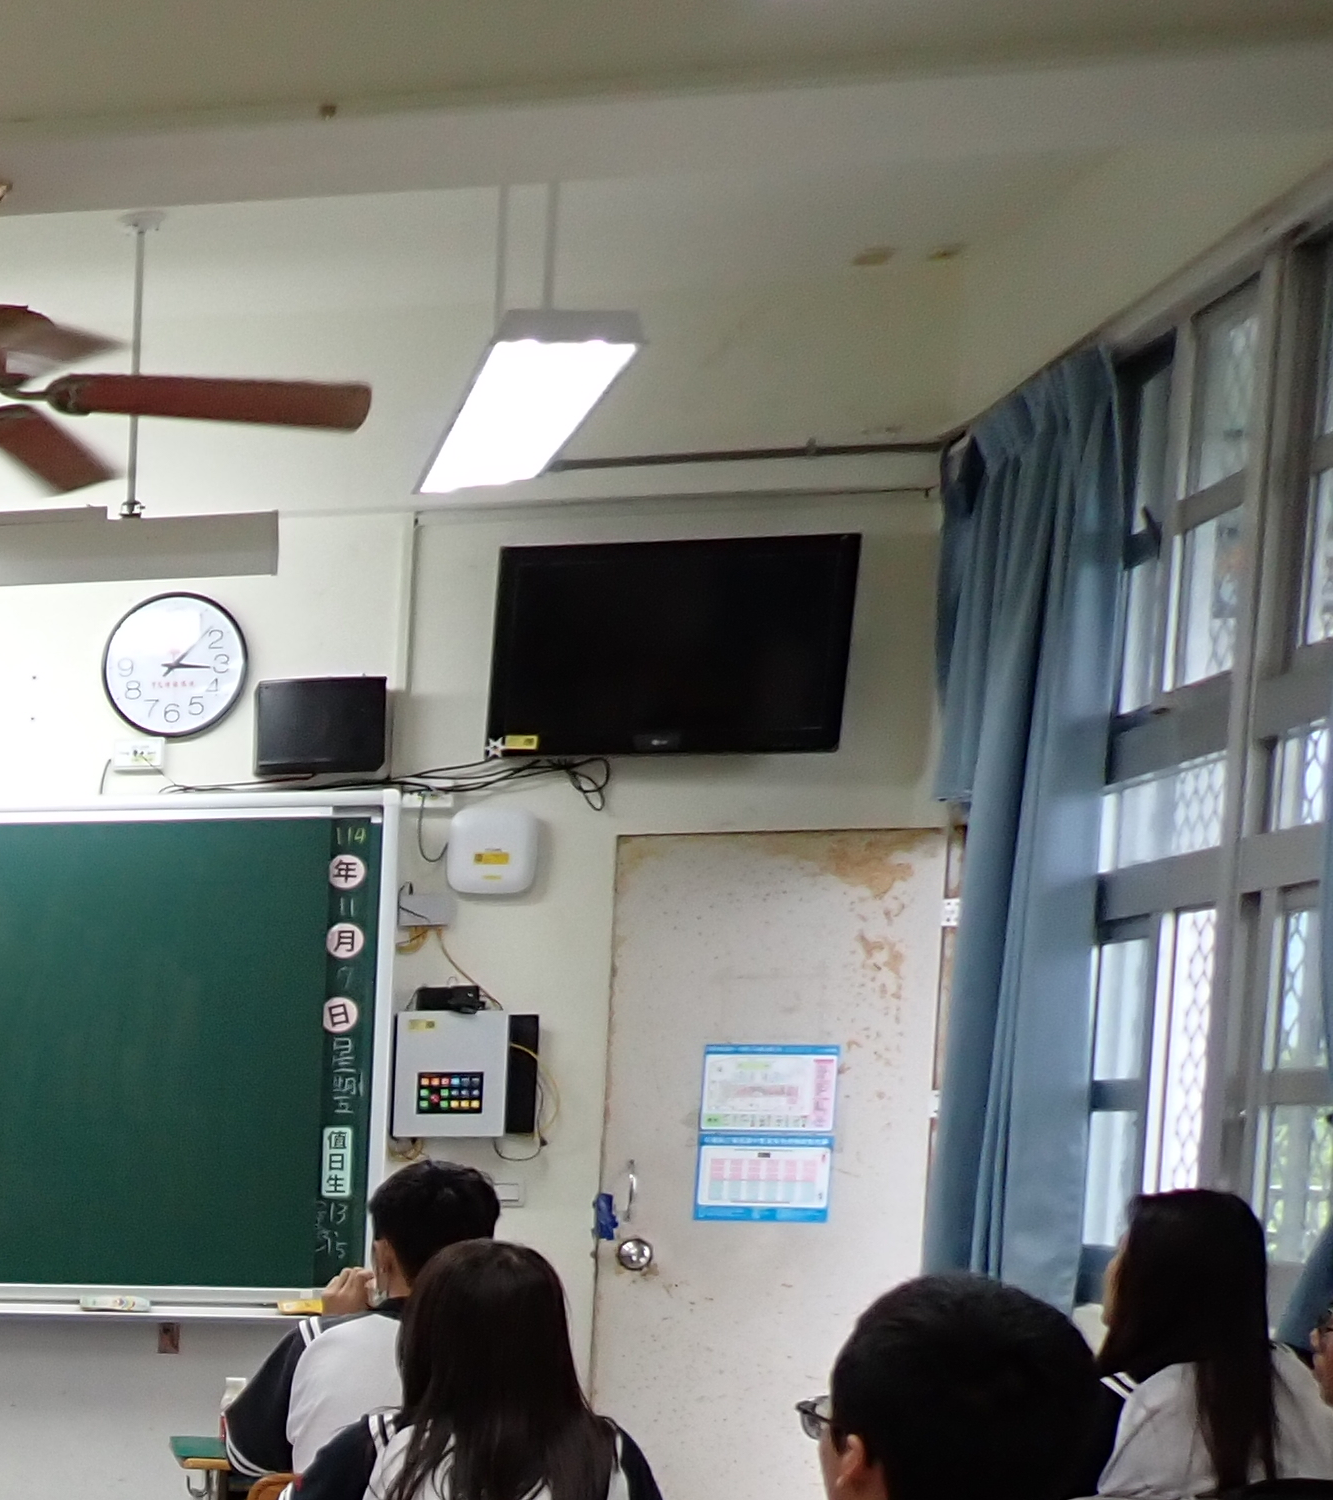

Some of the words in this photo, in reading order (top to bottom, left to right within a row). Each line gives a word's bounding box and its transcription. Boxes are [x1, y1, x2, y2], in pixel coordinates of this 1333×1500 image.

[208, 629, 224, 649] 2
[212, 653, 230, 674] 3
[124, 680, 142, 700] 8
[144, 698, 159, 718] 7
[163, 703, 180, 723] 6
[188, 696, 204, 716] 5
[333, 859, 358, 883] 年
[339, 897, 355, 917] 11
[334, 929, 355, 952] 月
[328, 1003, 349, 1026] 日
[326, 1131, 347, 1194] 值日生
